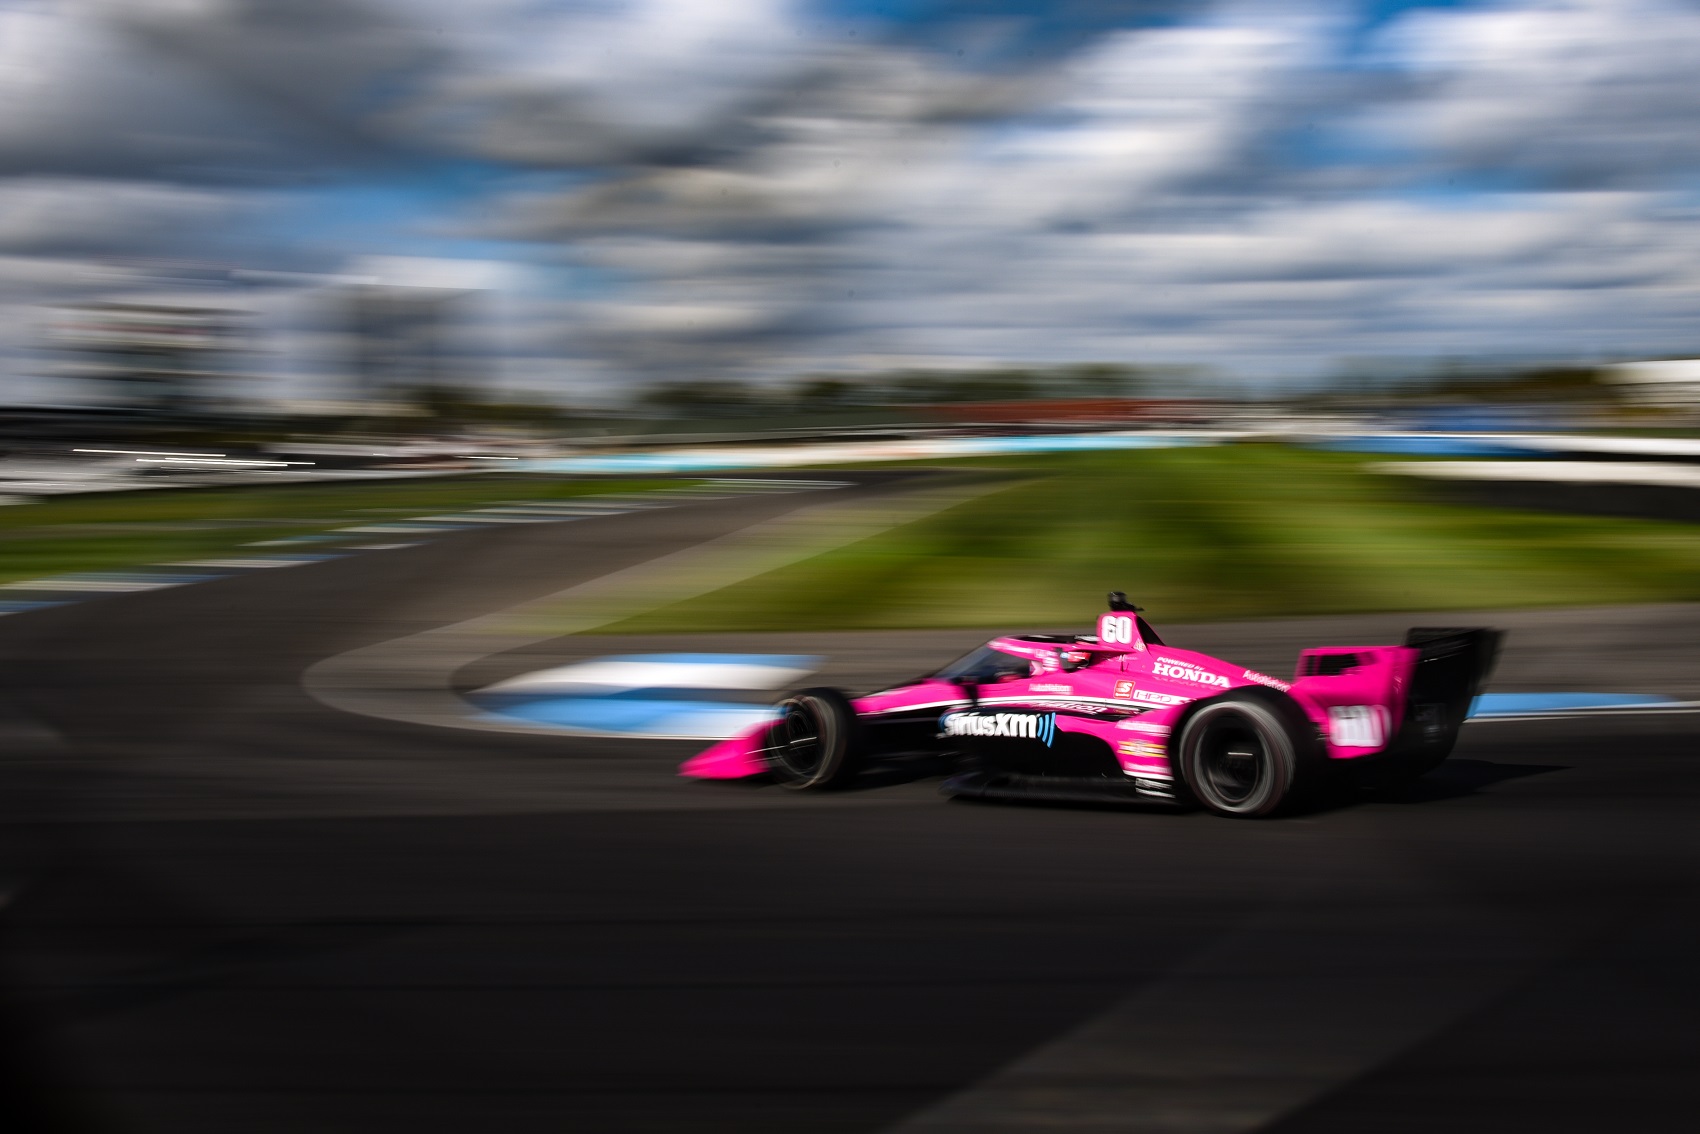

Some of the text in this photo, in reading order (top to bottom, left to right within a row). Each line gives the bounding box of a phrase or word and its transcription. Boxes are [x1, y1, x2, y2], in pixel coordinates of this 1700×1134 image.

[1101, 615, 1133, 644] 60
[1152, 662, 1232, 688] HONDA
[1156, 656, 1196, 669] POWERED
